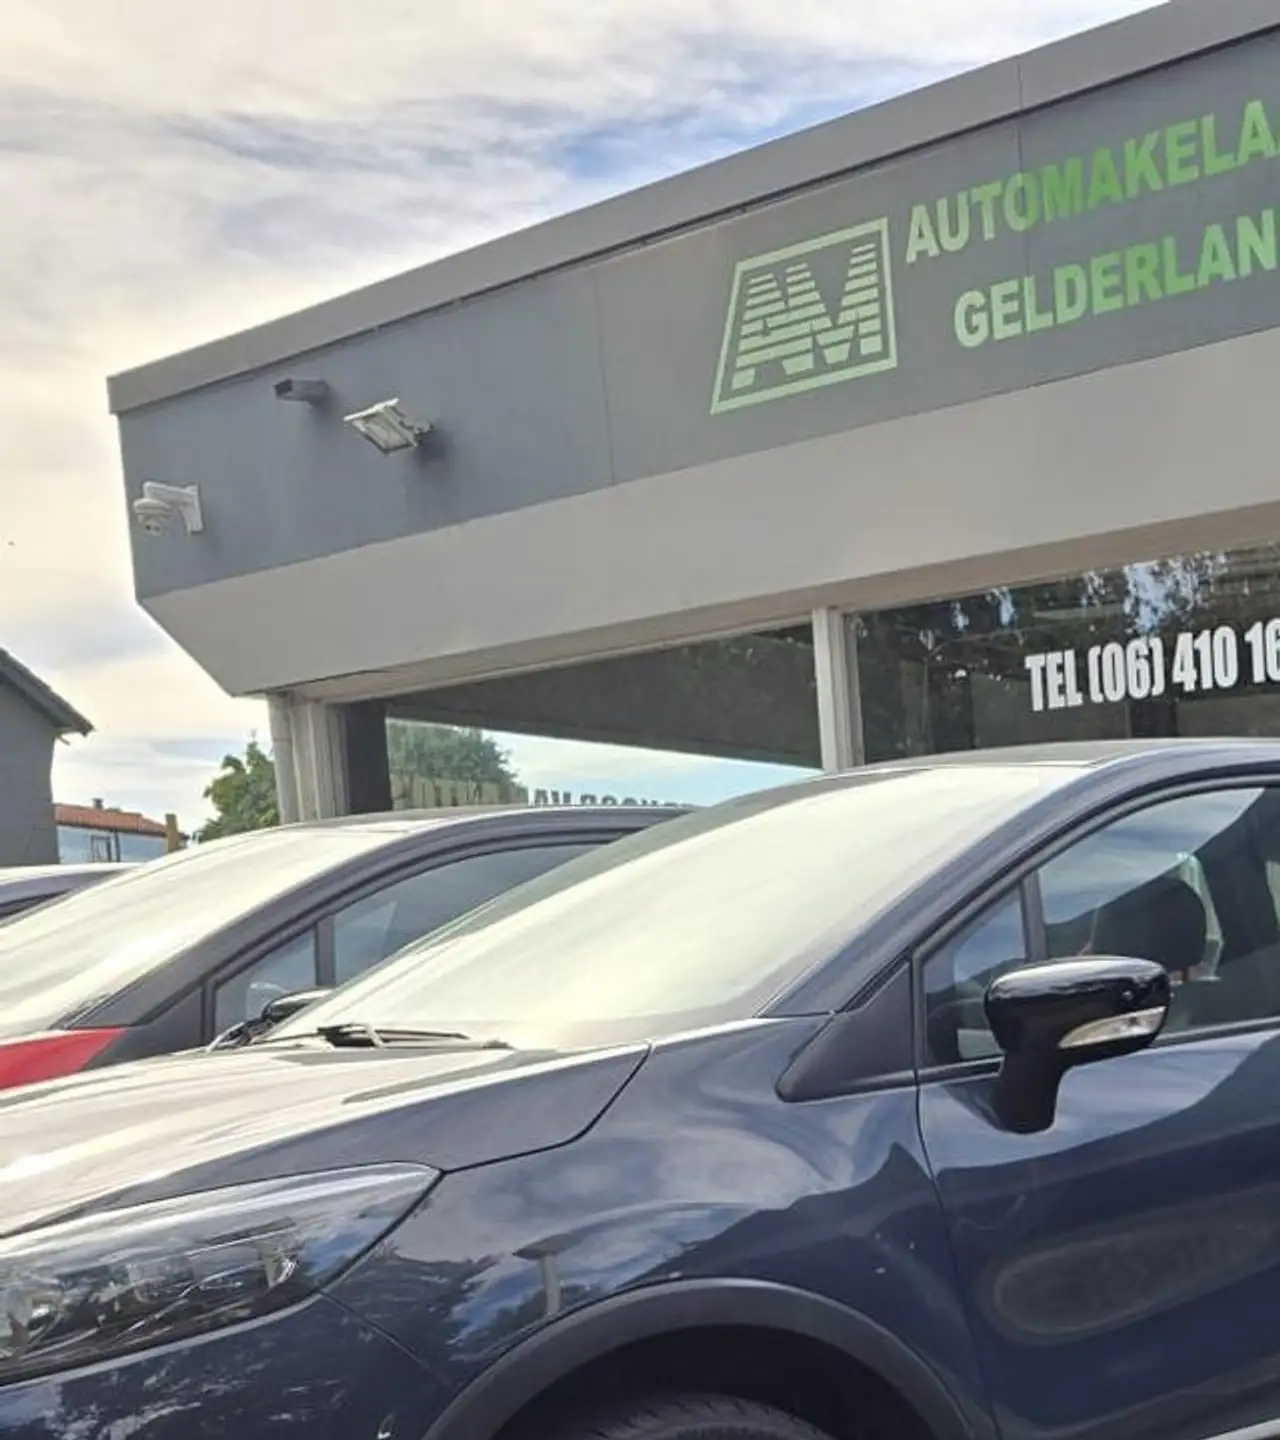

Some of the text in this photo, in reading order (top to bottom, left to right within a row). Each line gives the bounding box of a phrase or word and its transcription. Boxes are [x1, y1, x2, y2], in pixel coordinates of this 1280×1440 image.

[1025, 650, 1084, 712] TEL
[1087, 637, 1166, 704] (06)
[1172, 625, 1238, 693] 410
